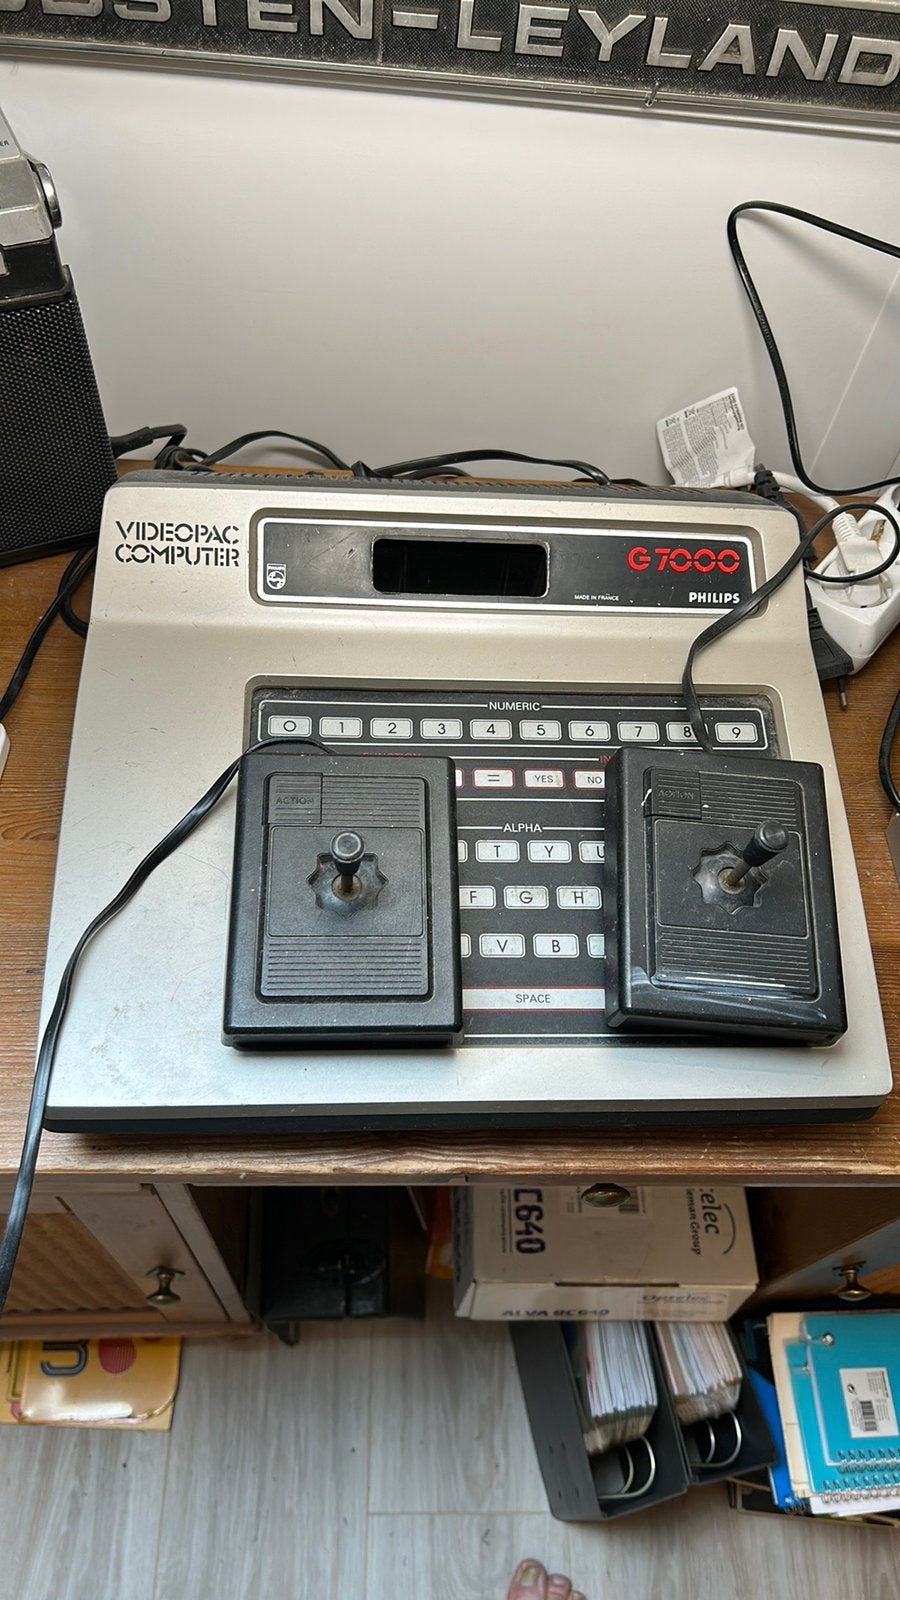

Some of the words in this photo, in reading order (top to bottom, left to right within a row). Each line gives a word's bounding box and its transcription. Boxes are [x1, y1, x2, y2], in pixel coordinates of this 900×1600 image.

[115, 520, 240, 545] VIDEOPAC
[115, 543, 240, 567] COMPUTER
[626, 546, 740, 573] G7000
[688, 591, 740, 604] PHILIPS
[488, 701, 541, 711] NUMERIC
[339, 721, 344, 734] 1
[387, 722, 397, 734] 2
[437, 723, 447, 735] 3
[486, 723, 496, 735] 4
[536, 724, 546, 736] 5
[585, 725, 595, 737] 6
[634, 725, 643, 738] 7
[683, 726, 692, 738] 8
[732, 727, 741, 739] 9
[535, 775, 554, 784] YES
[587, 776, 603, 785] NO
[503, 823, 543, 833] ALPHA
[493, 845, 501, 858] T
[544, 845, 554, 858] Y
[469, 890, 477, 904] F
[519, 890, 533, 904] G
[574, 891, 584, 904] H
[496, 939, 508, 953] V
[552, 939, 561, 953] B
[515, 993, 551, 1004] SPACE
[699, 1188, 722, 1236] elec
[690, 1221, 702, 1256] Group
